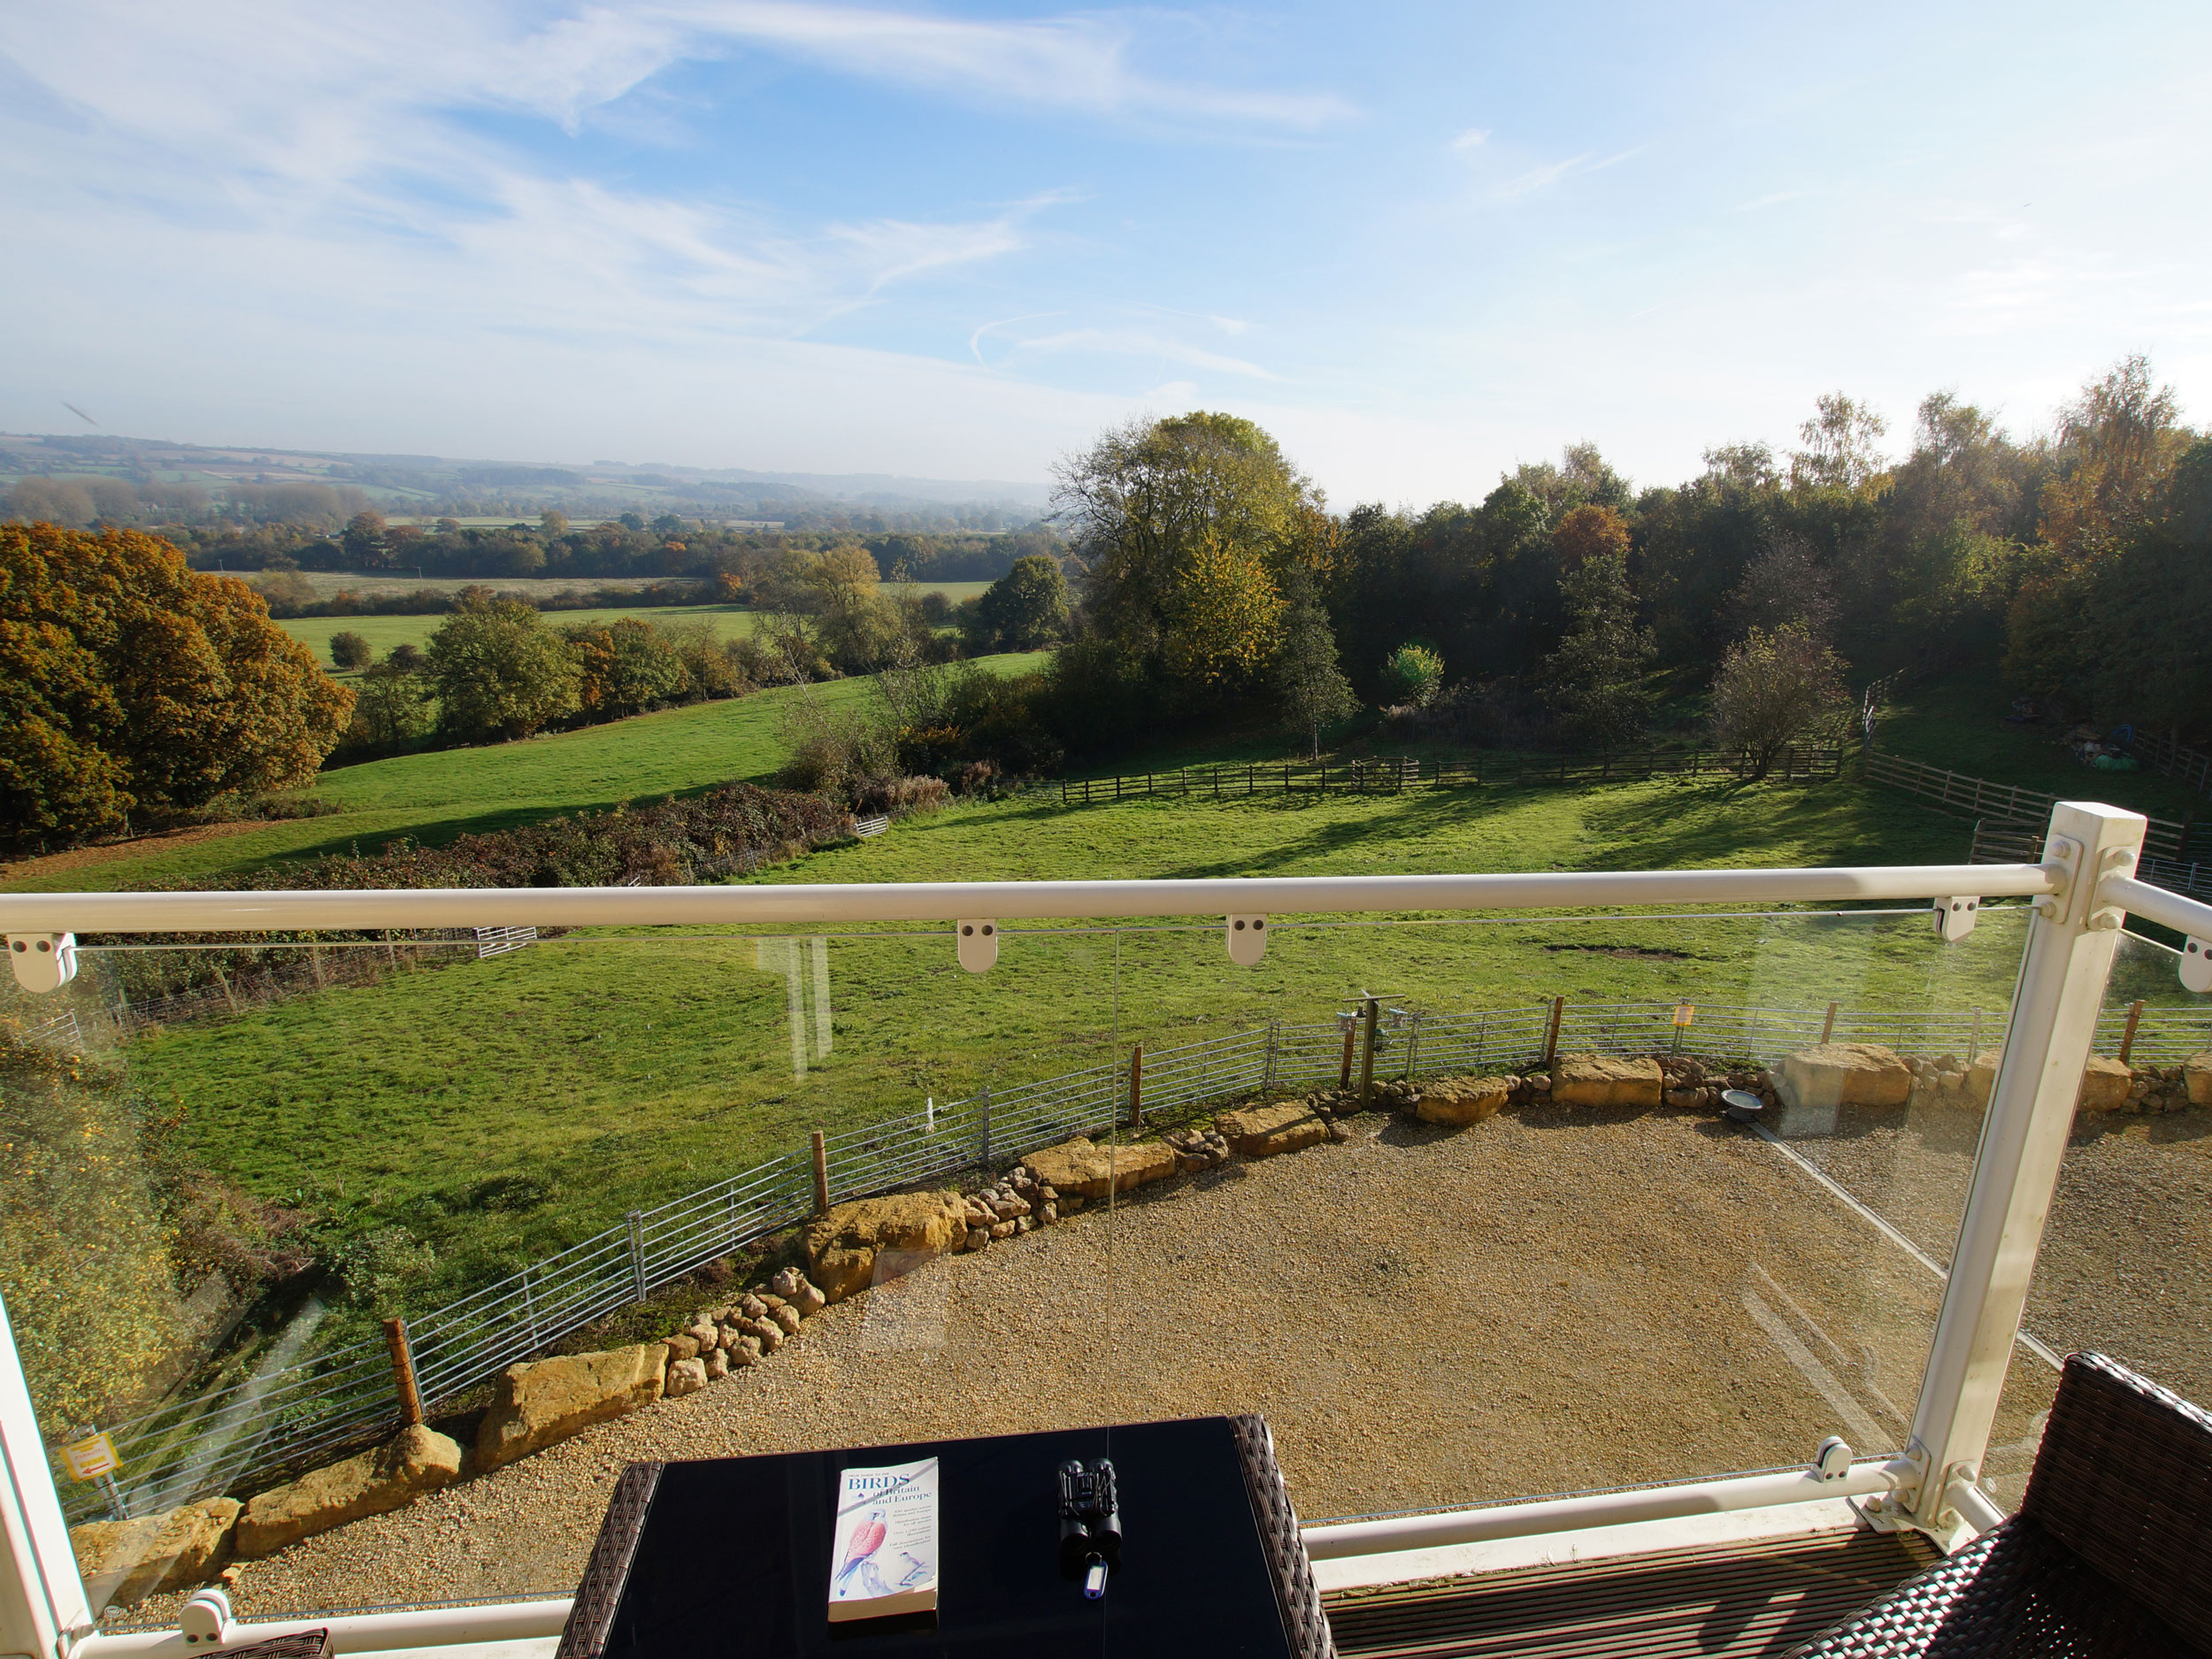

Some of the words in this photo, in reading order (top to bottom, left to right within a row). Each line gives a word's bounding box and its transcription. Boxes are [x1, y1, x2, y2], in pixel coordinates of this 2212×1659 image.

[849, 1473, 910, 1490] BIRDS
[872, 1488, 885, 1497] of
[885, 1485, 920, 1495] Britain
[872, 1495, 892, 1506] and
[895, 1492, 933, 1503] Europe
